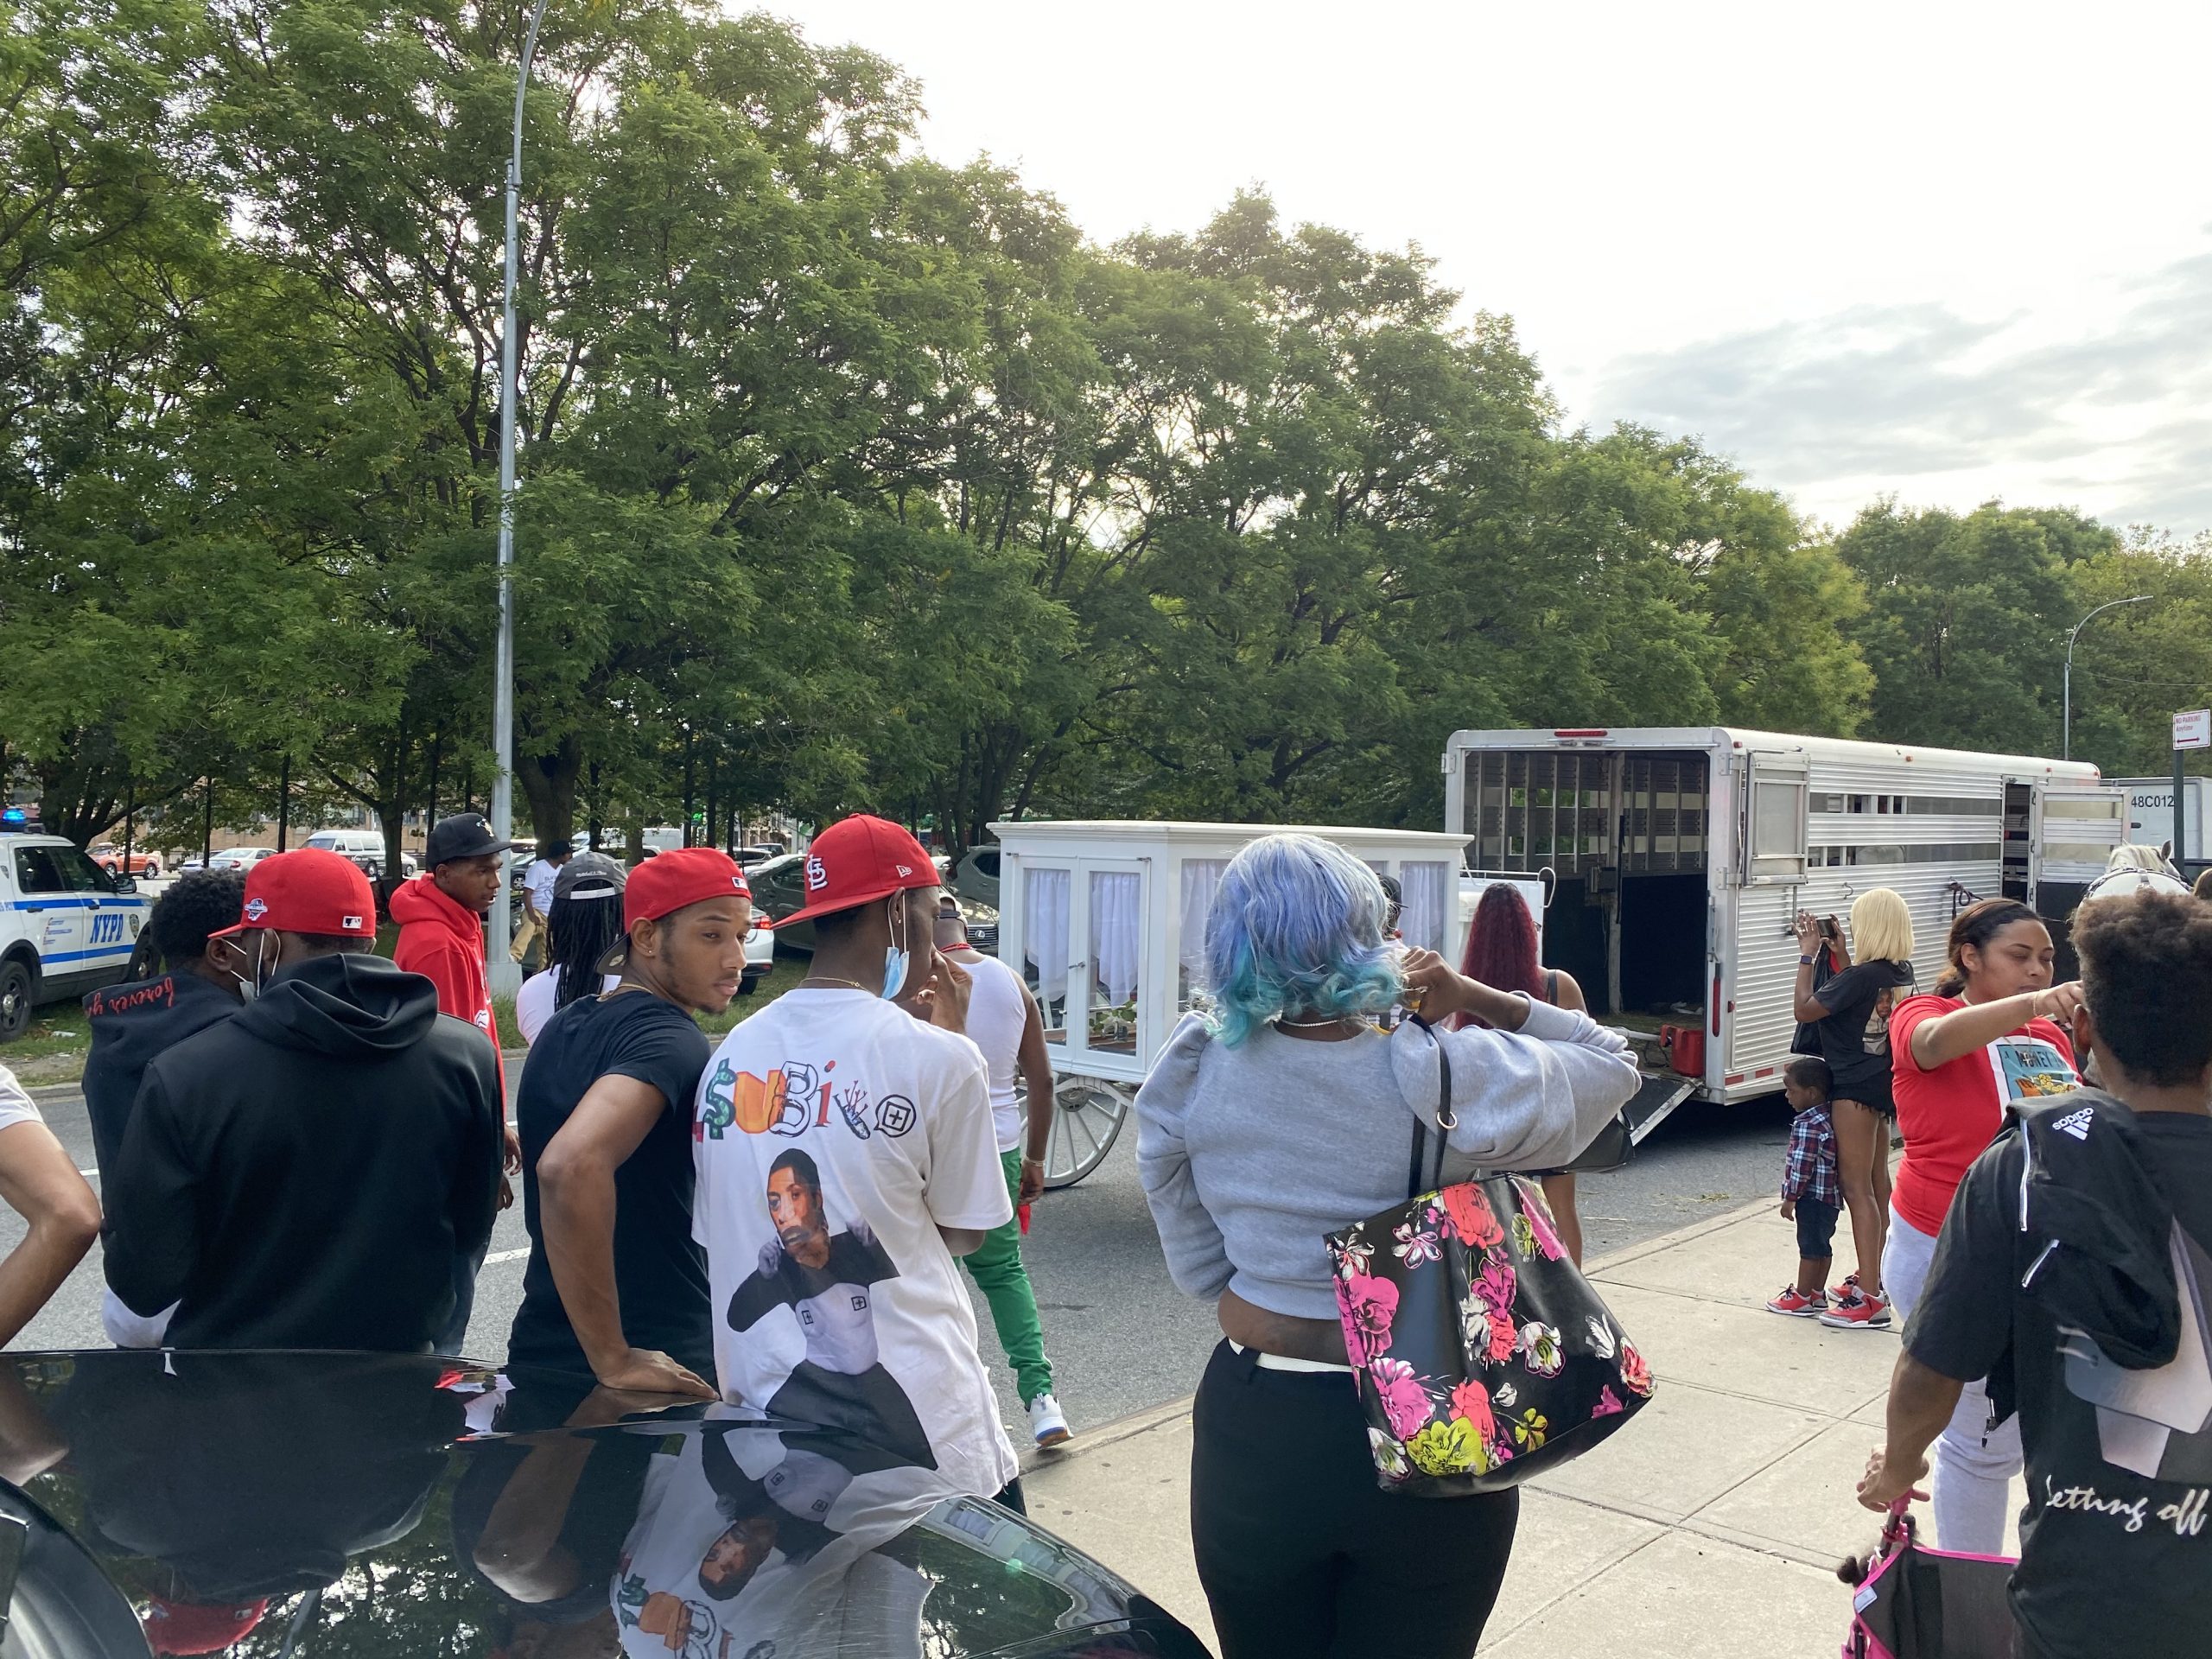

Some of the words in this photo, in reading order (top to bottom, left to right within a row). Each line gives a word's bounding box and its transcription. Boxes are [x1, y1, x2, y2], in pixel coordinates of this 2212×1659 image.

[2131, 795, 2175, 808] 48C012
[89, 913, 124, 944] NYPD
[2052, 1107, 2094, 1130] adidas
